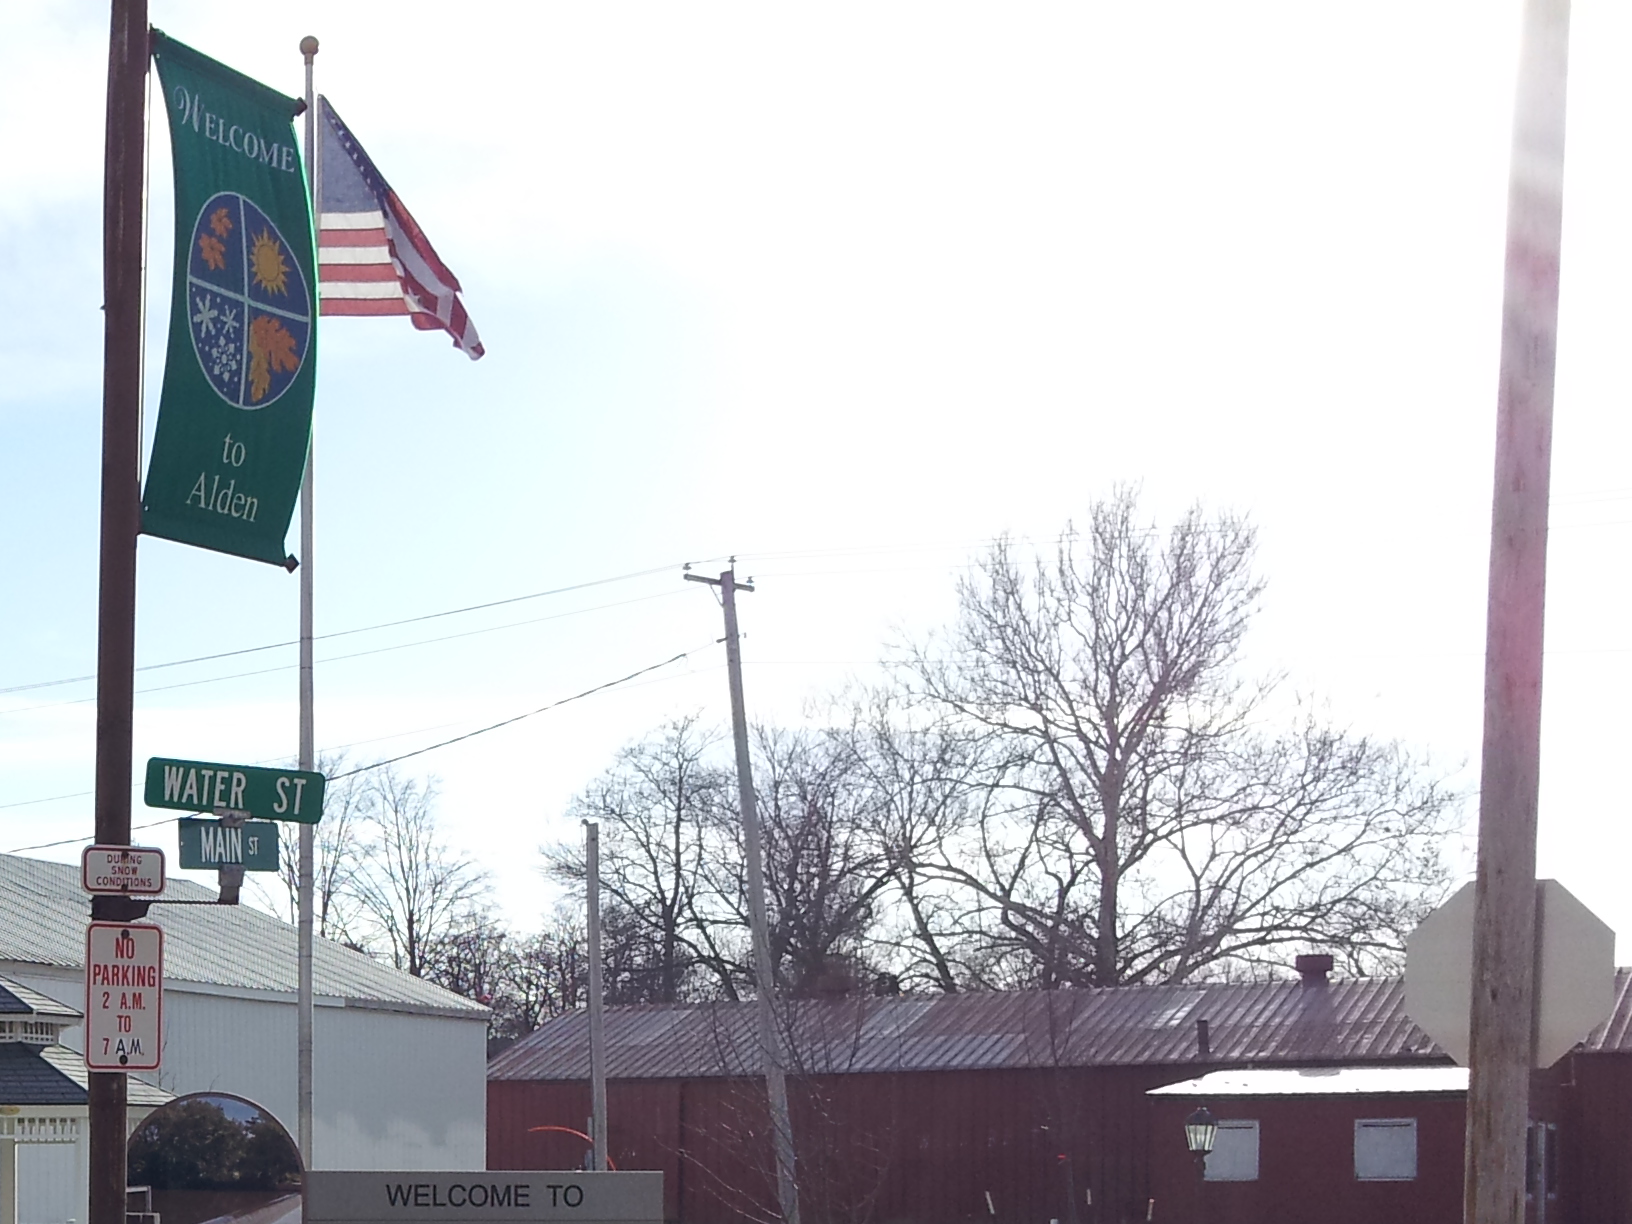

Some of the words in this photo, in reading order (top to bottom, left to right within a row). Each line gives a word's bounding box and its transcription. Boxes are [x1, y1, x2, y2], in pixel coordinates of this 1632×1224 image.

[173, 86, 296, 174] WELCOME
[222, 433, 246, 468] to
[186, 472, 259, 523] Alden
[164, 765, 247, 809] WATER
[273, 776, 307, 815] ST
[200, 826, 243, 863] MAIN
[248, 837, 259, 856] ST
[96, 876, 152, 888] CONDITIONS
[111, 866, 138, 875] SNOW
[115, 937, 135, 959] NO
[93, 964, 156, 988] PARKING
[102, 992, 110, 1010] 2
[120, 992, 146, 1010] A.M.
[117, 1015, 132, 1033] TO
[102, 1038, 110, 1055] 7
[115, 1038, 145, 1056] A.M.
[386, 1184, 531, 1208] WELCOME
[547, 1184, 585, 1208] TO
